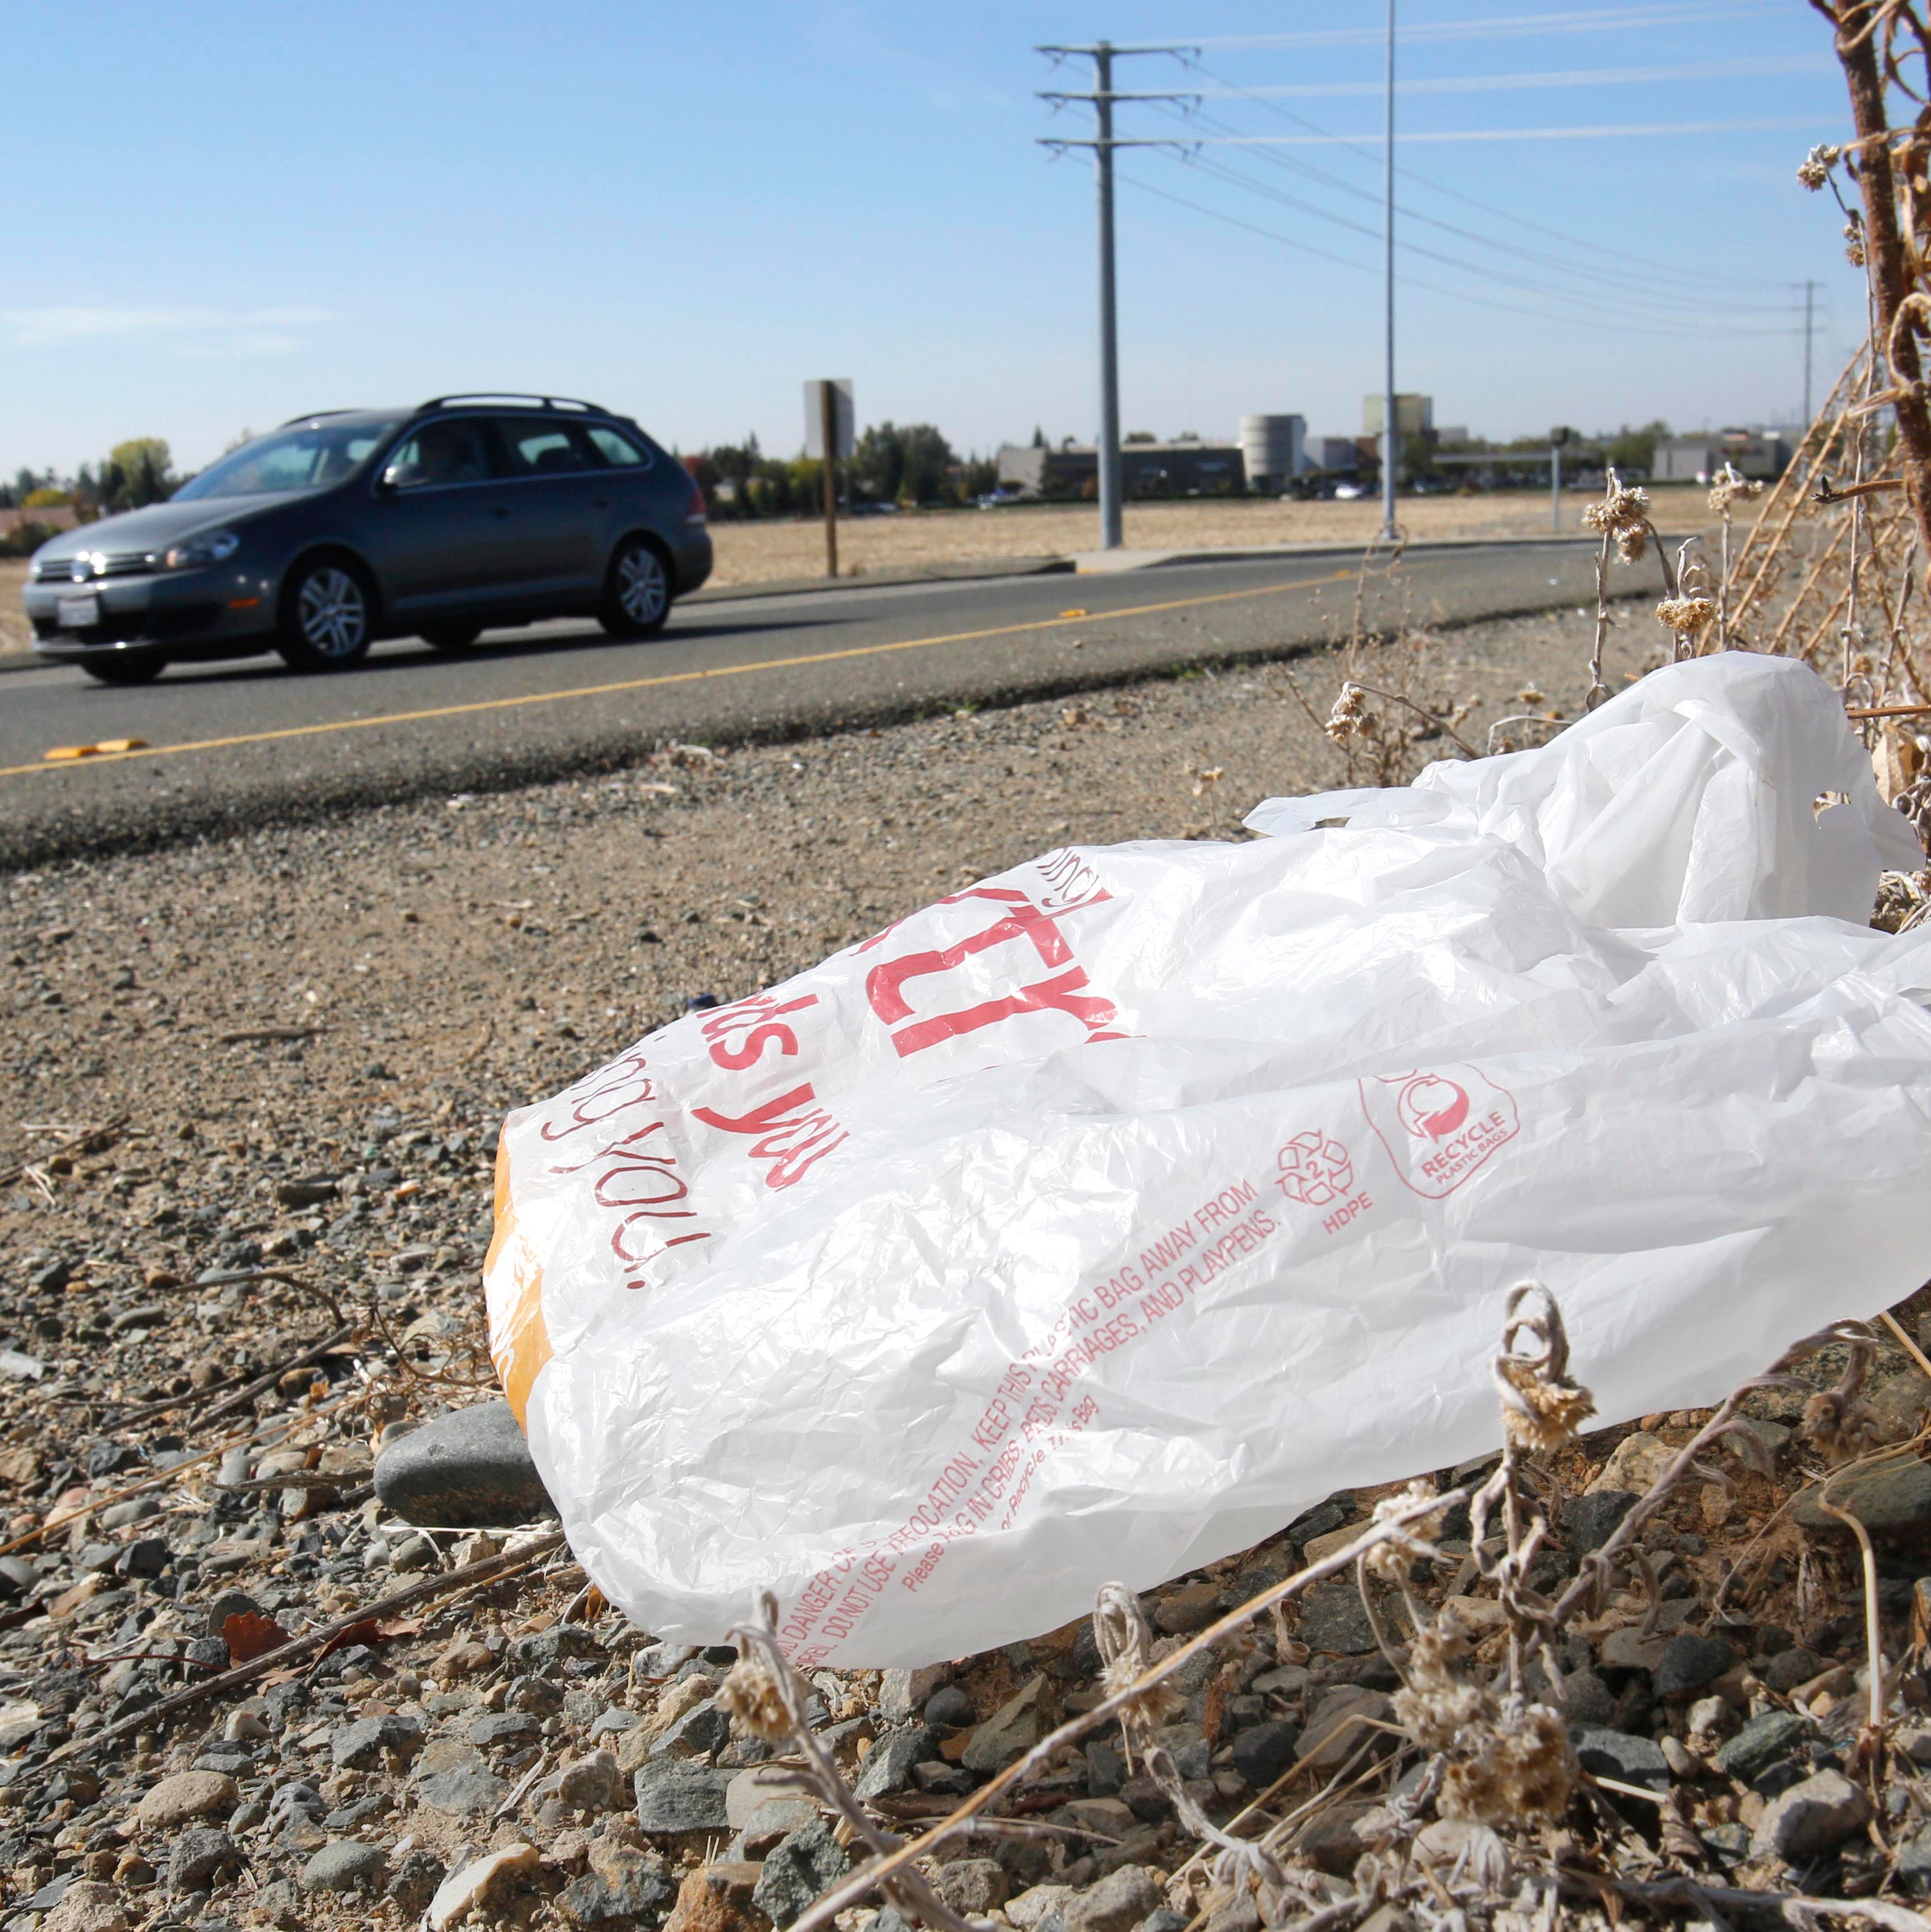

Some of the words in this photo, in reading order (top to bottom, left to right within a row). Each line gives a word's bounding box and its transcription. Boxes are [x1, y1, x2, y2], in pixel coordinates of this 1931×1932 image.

[696, 993, 819, 1071] rds
[541, 1034, 667, 1141] ing
[689, 1082, 850, 1192] you
[1421, 1110, 1506, 1178] RECYCLE
[1436, 1150, 1479, 1184] PLASTIC
[1477, 1128, 1508, 1153] BAGS
[1305, 1160, 1325, 1179] 2
[548, 1122, 712, 1290] you.
[1322, 1190, 1374, 1235] HDPE
[1177, 1209, 1281, 1295] PLAYPENS.
[1140, 1282, 1185, 1324] AND
[1041, 1313, 1147, 1402] CARRIAGES,
[781, 1570, 842, 1640] DANGER
[971, 1399, 1013, 1452] KEEP
[997, 1363, 1031, 1404] THIS
[1094, 1266, 1145, 1309] BAG
[1140, 1220, 1198, 1279] AWAY
[1194, 1178, 1258, 1234] FROM
[901, 1542, 945, 1593] Please
[1009, 1449, 1046, 1516] Recycle
[1071, 1395, 1100, 1424] Bag
[981, 1440, 1024, 1499] CRIBS,
[966, 1491, 993, 1522] IN
[836, 1585, 874, 1618] NOT
[856, 1550, 897, 1593] USE
[822, 1616, 854, 1638] DO
